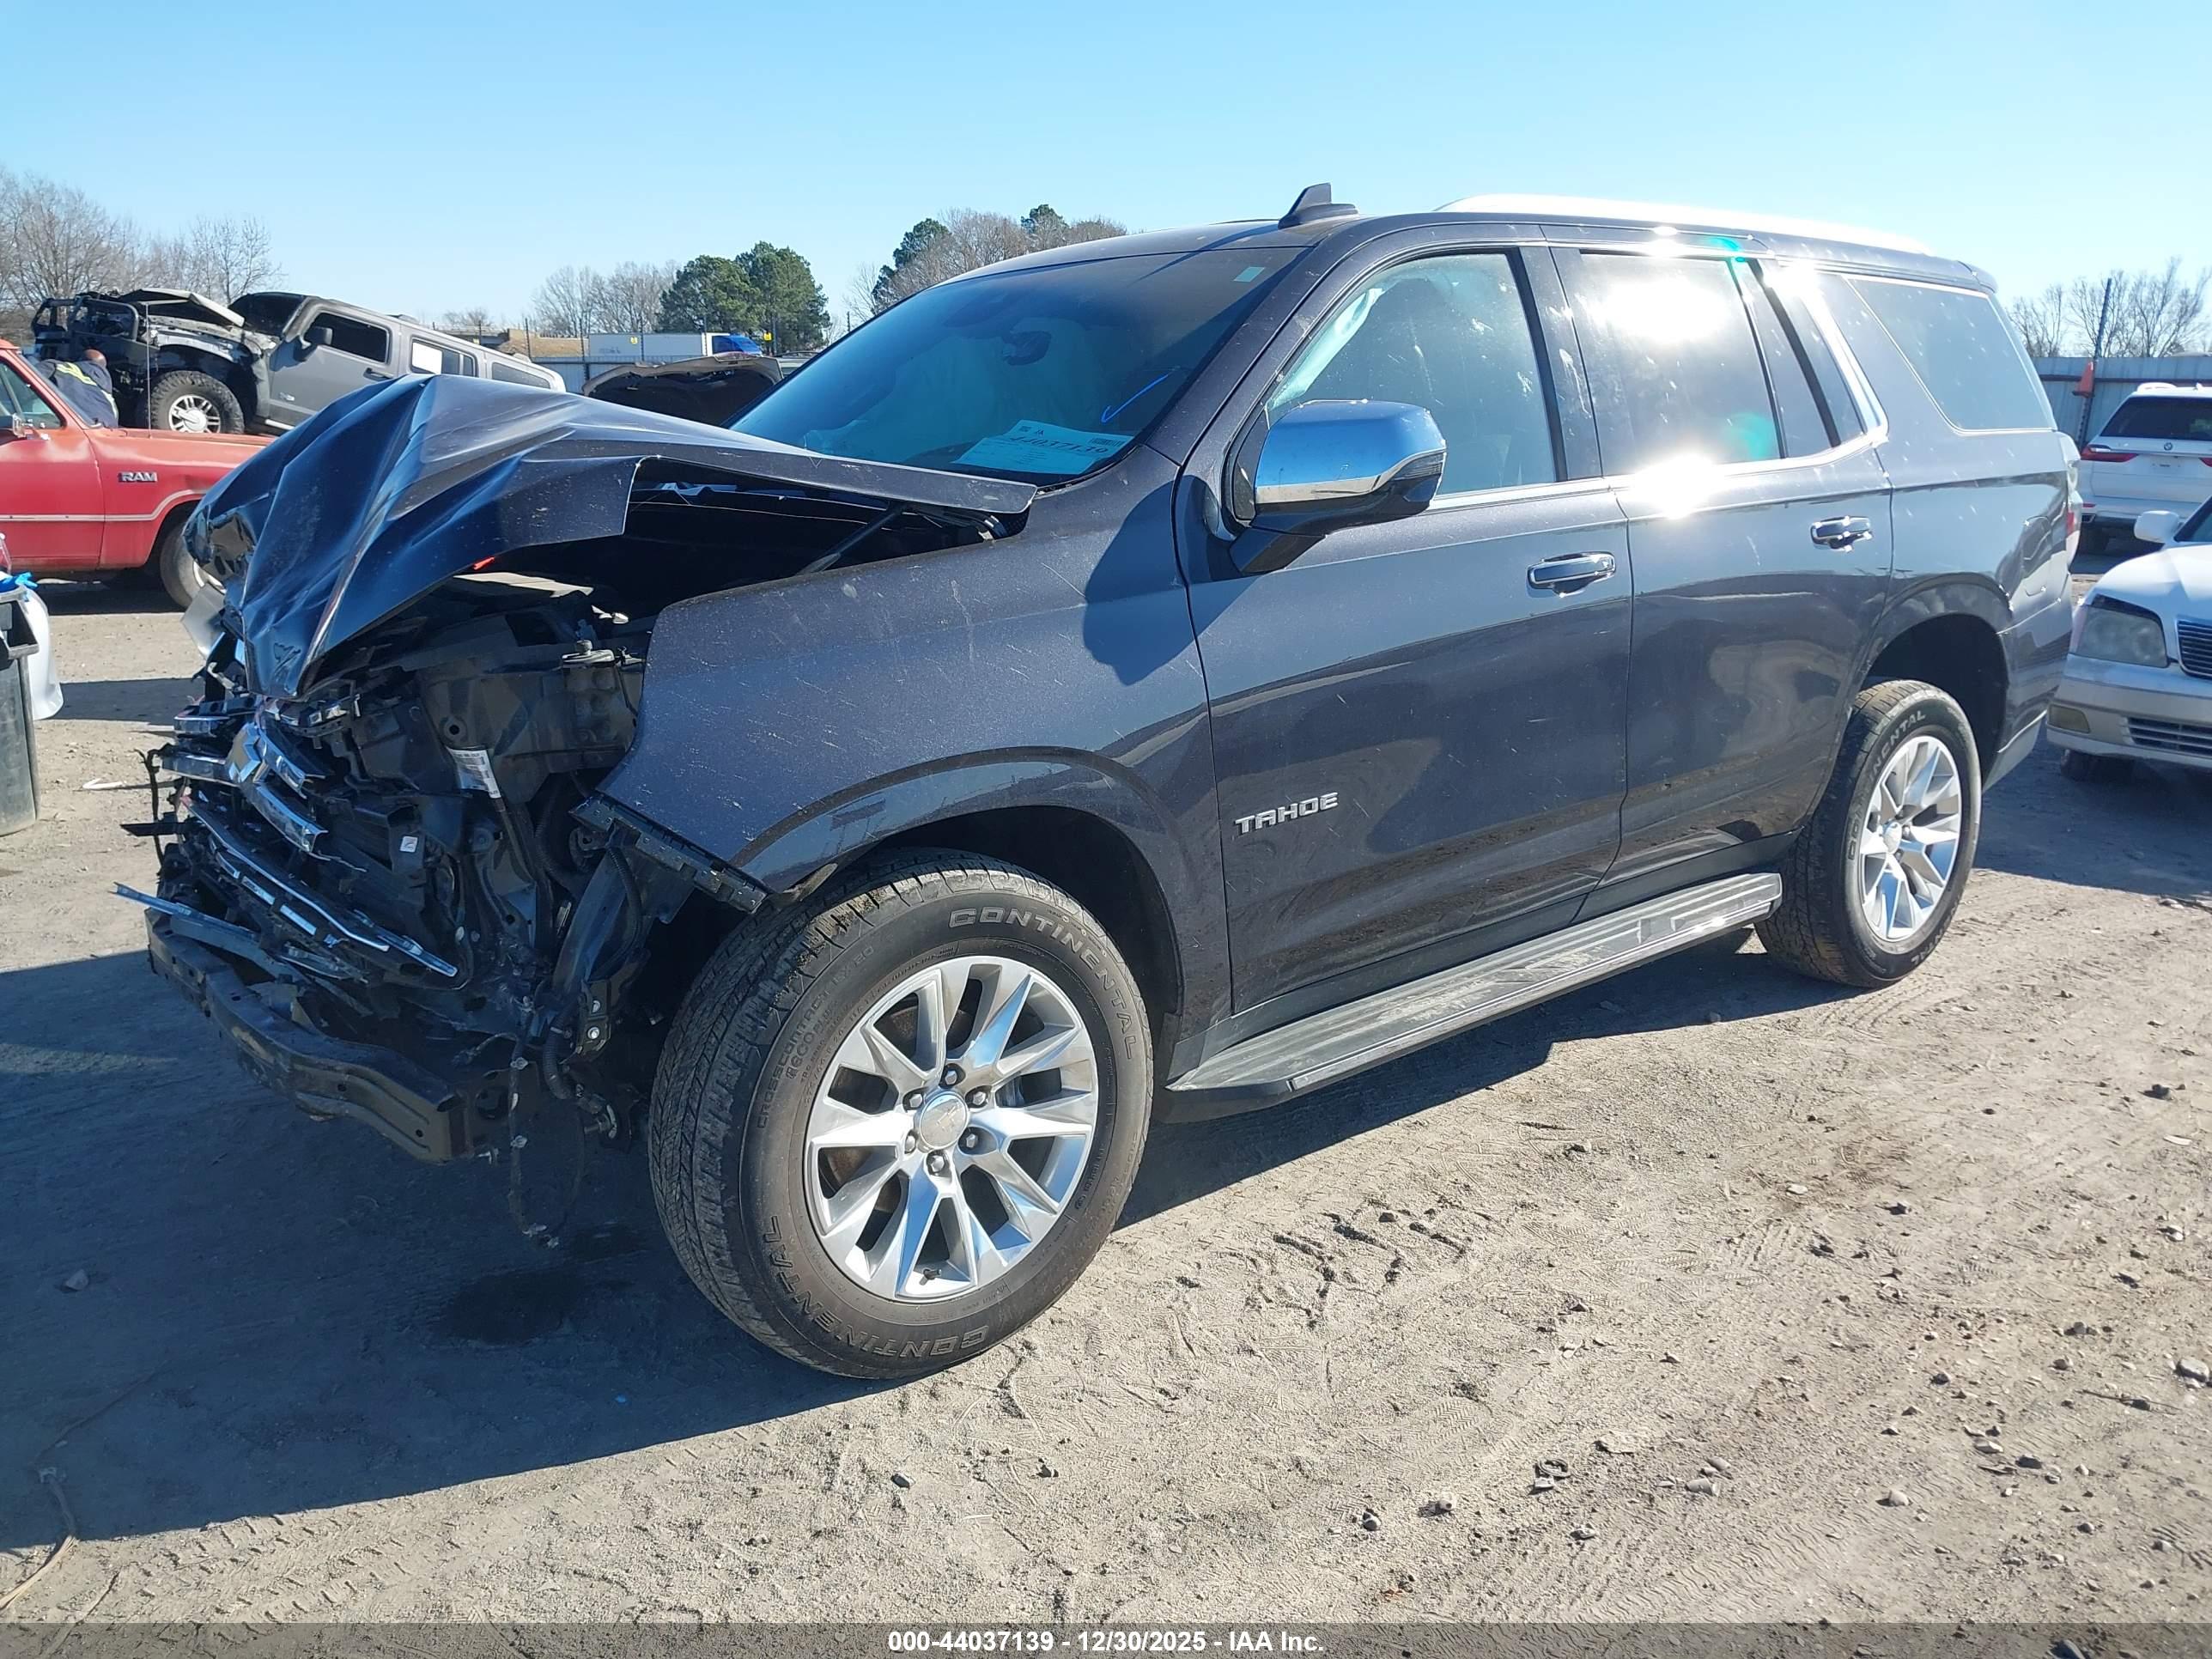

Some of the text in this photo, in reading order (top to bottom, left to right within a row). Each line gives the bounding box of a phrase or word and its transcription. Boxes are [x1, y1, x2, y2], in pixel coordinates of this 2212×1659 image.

[120, 471, 159, 483] RAM
[1234, 791, 1340, 835] TAHOE
[1848, 709, 1929, 860] COINENTAL
[948, 905, 1138, 1060] CONTINENTAL
[763, 1214, 990, 1357] CONTINENTAL
